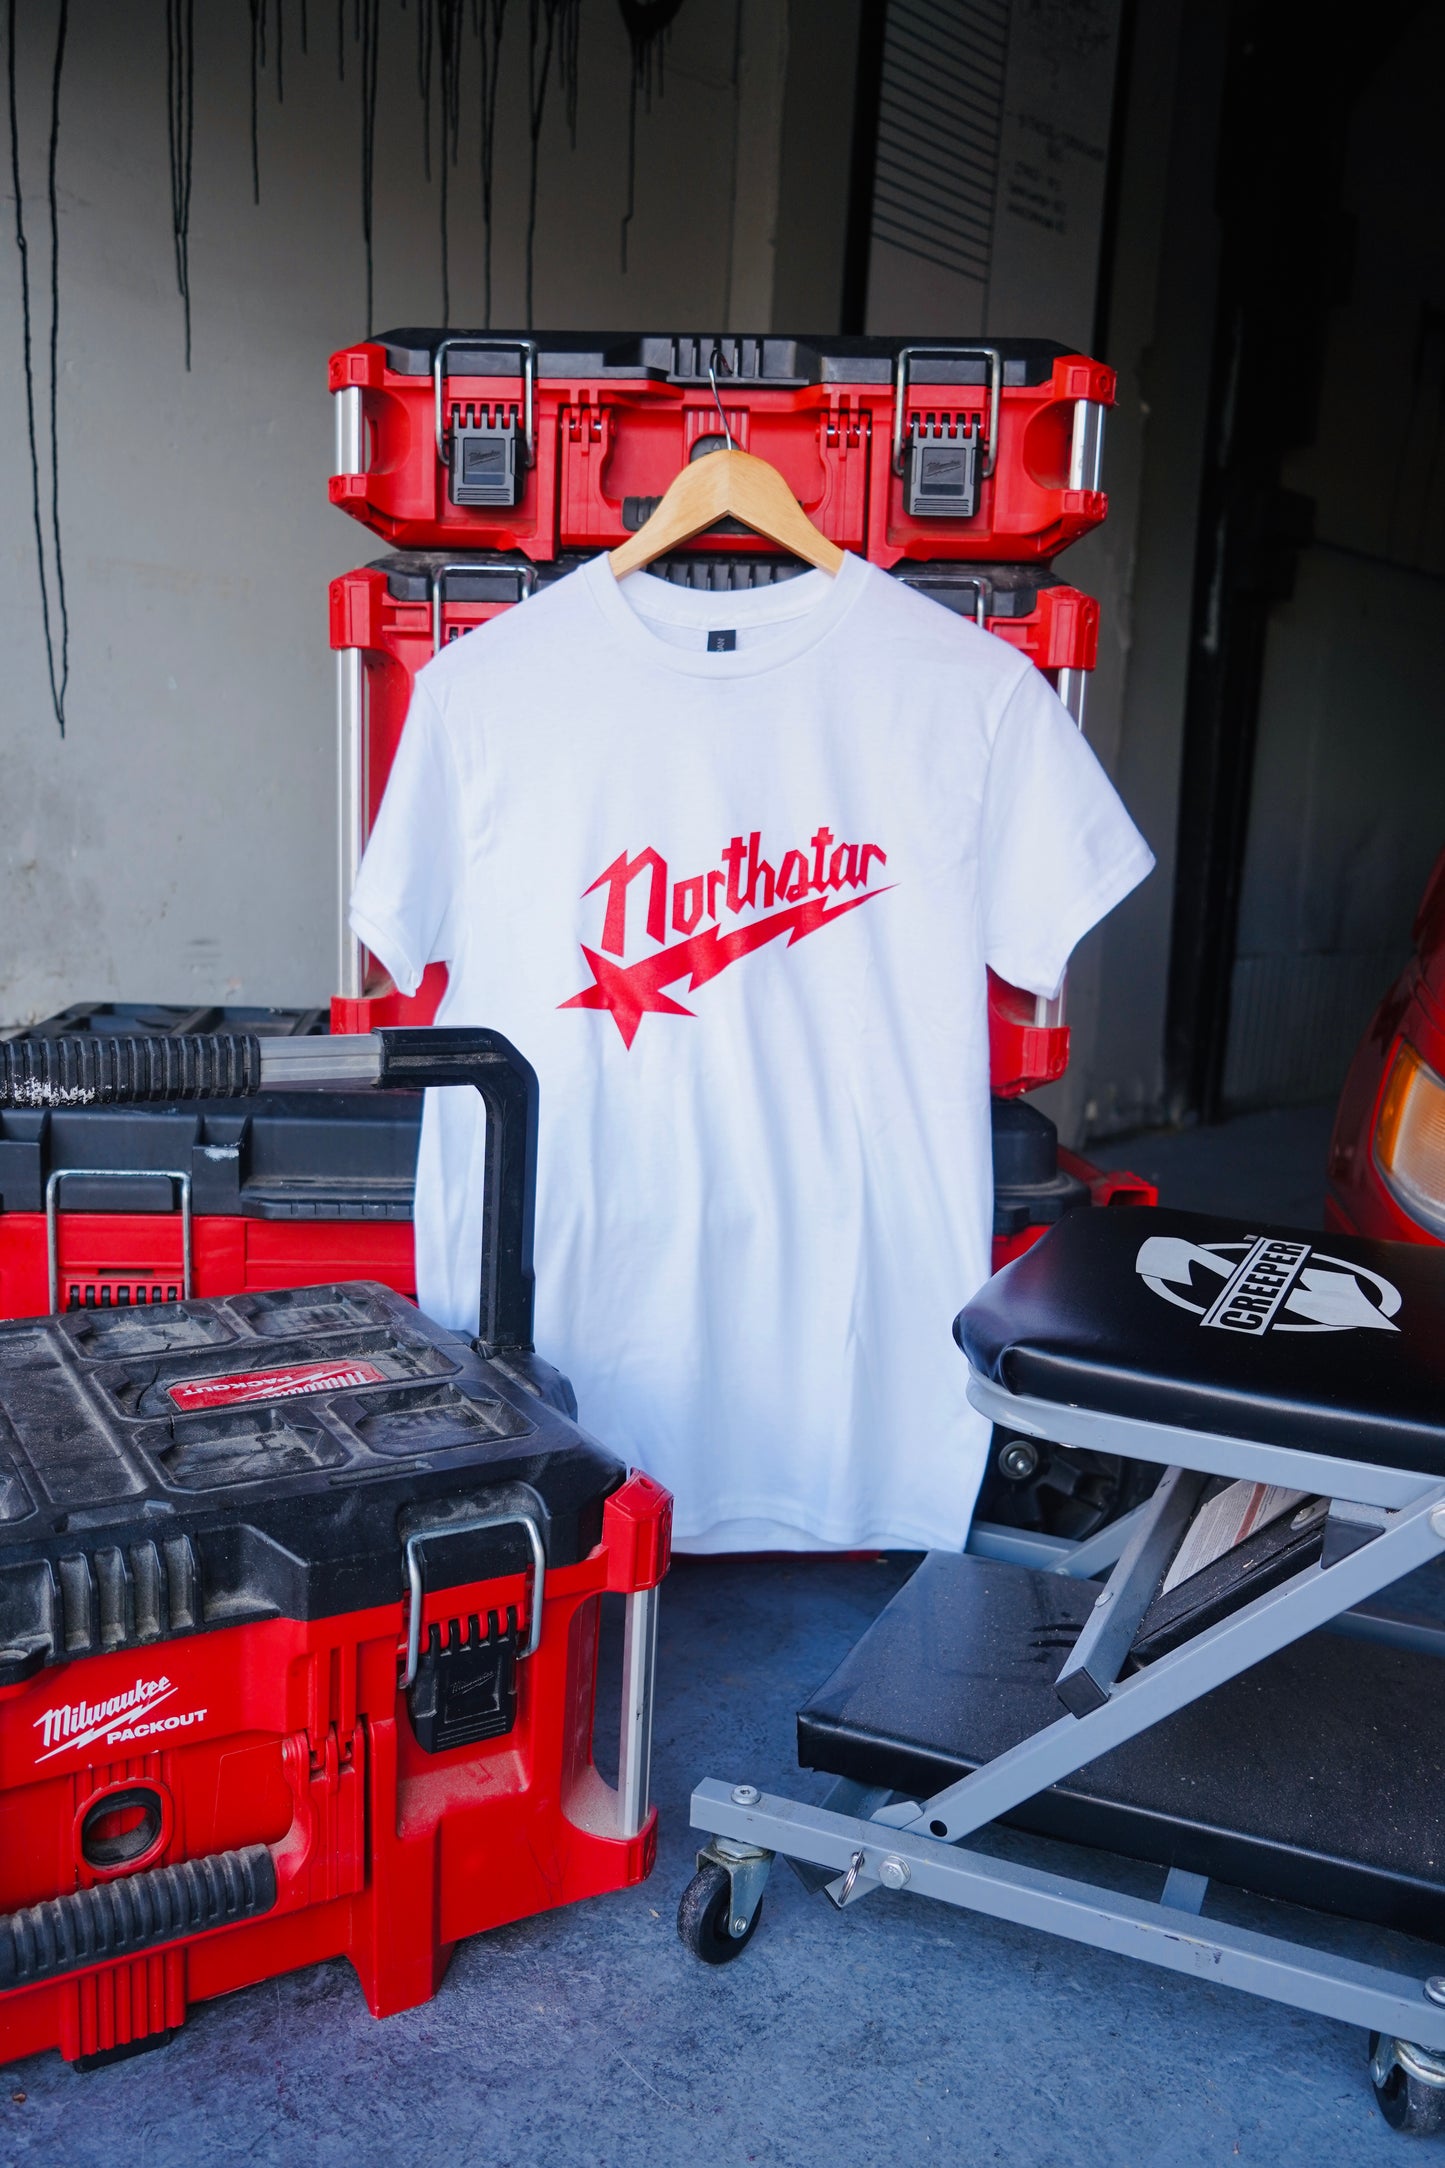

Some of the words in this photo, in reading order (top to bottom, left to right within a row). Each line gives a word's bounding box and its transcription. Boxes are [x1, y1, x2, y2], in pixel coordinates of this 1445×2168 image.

[1220, 1242, 1304, 1330] CREEPER
[182, 1376, 293, 1396] PACKOUT
[33, 1676, 172, 1747] Milwaukee
[107, 1709, 208, 1745] PACKOUT
